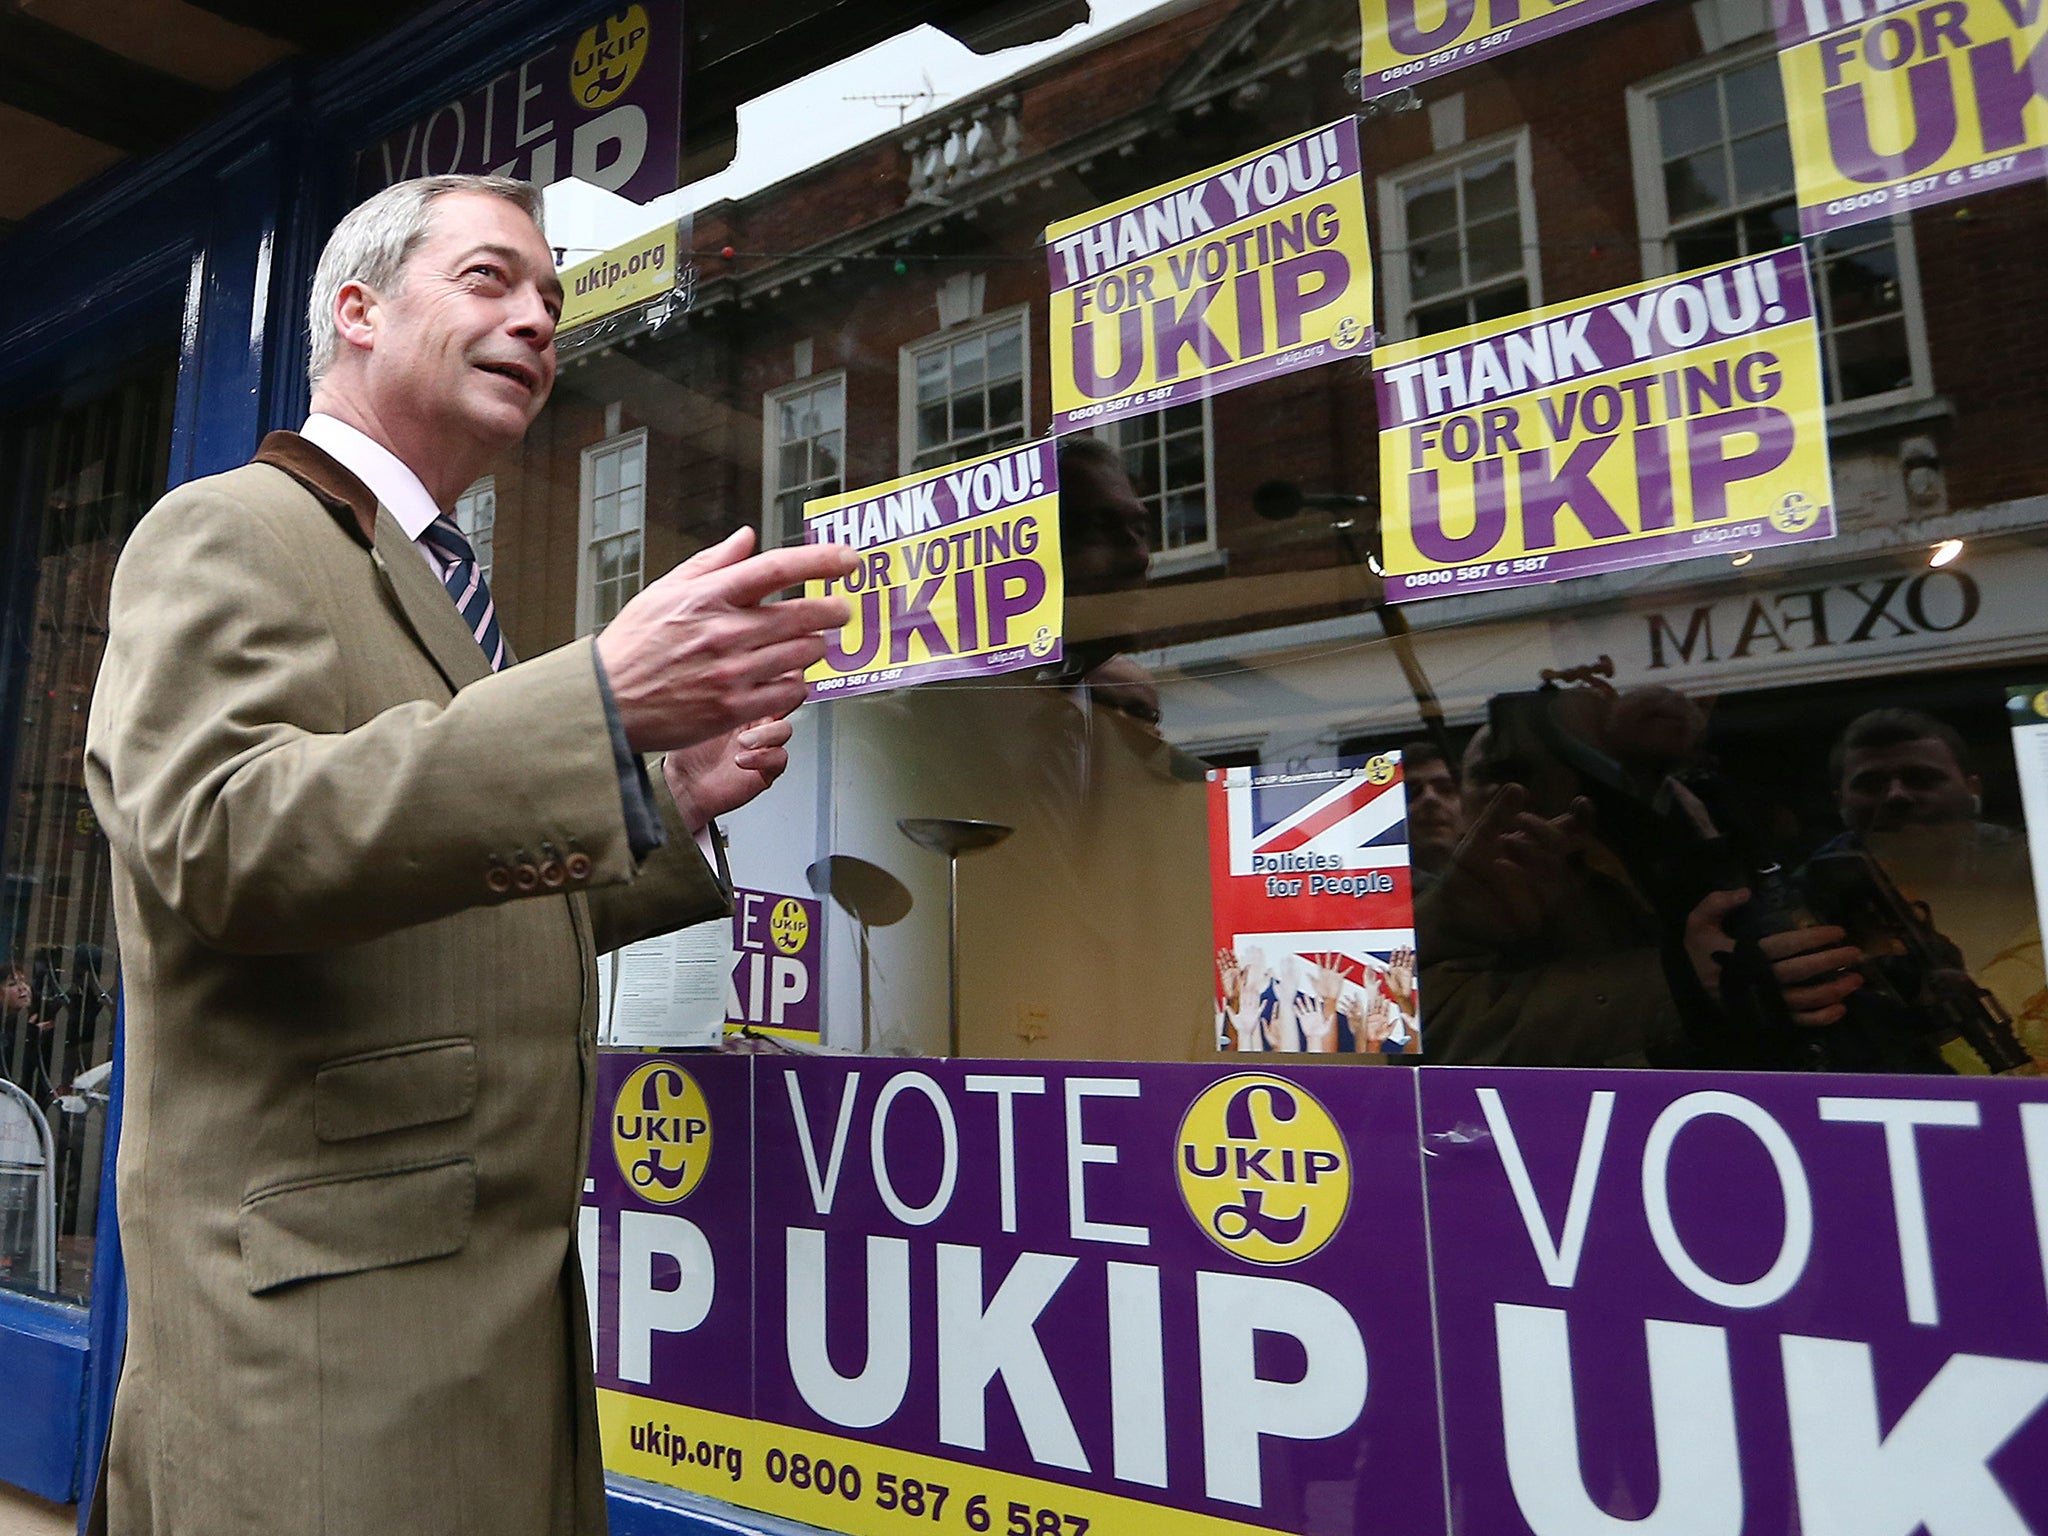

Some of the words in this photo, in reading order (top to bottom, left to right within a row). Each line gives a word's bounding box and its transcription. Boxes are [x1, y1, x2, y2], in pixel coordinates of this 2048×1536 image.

[573, 26, 646, 77] UKIP
[1381, 60, 1424, 83] 0800
[1428, 49, 1459, 69] 587
[1463, 43, 1476, 56] 6
[1480, 28, 1513, 50] 587
[1819, 1, 1973, 88] FOR
[1054, 185, 1215, 284] THANK
[1219, 129, 1342, 218] YOU!
[1826, 190, 1889, 216] 0800
[1894, 176, 1939, 201] 587
[1945, 170, 1964, 187] 6
[1968, 155, 2018, 180] 587
[575, 243, 665, 296] ukip.org
[1074, 265, 1154, 322] FOR
[1168, 203, 1340, 291] VOTING
[1071, 248, 1350, 399] UKIP
[1384, 313, 1604, 421] THANK
[1609, 258, 1786, 359] YOU!
[1275, 344, 1325, 366] ukip.org
[1068, 404, 1103, 422] 0800
[1106, 397, 1132, 415] 587
[1134, 394, 1145, 406] 6
[1147, 386, 1174, 402] 587
[1410, 406, 1521, 469] FOR
[1537, 351, 1782, 443] VOTING
[810, 481, 942, 549] THANK
[944, 447, 1045, 519] YOU!
[1408, 406, 1795, 563] UKIP
[901, 516, 1039, 581] VOTING
[1692, 521, 1763, 545] ukip.org
[1404, 570, 1453, 588] 0800
[1456, 564, 1490, 582] 587
[1493, 562, 1509, 577] 6
[1512, 556, 1549, 574] 587
[824, 558, 1046, 672] UKIP
[816, 679, 844, 692] 0800
[846, 675, 868, 687] 587
[869, 673, 879, 684] 6
[880, 669, 903, 681] 587
[1252, 853, 1342, 874] Policies
[1266, 876, 1303, 897] for
[1308, 871, 1393, 899] People
[772, 918, 808, 933] UKIP
[616, 1114, 707, 1144] UKIP
[783, 1069, 1150, 1245] VOTE
[1183, 1144, 1340, 1184] UKIP
[1475, 1088, 2048, 1326] VOT
[786, 1226, 1368, 1508] UKIP
[630, 1421, 743, 1482] ukip.org
[766, 1448, 862, 1500] 0800
[876, 1472, 950, 1522] 587
[965, 1495, 990, 1532] 6
